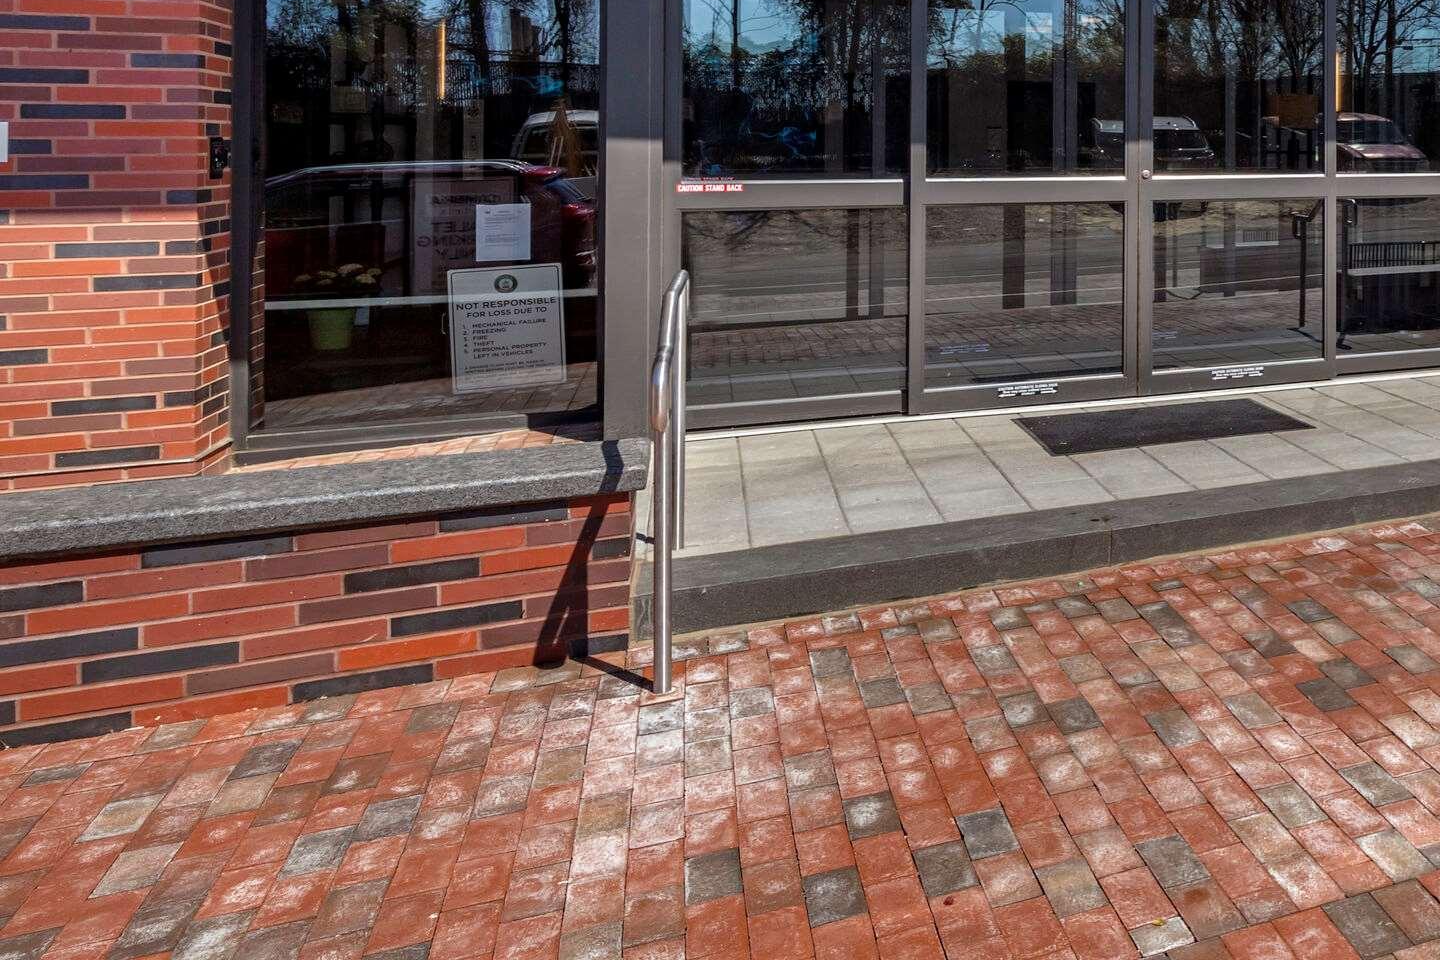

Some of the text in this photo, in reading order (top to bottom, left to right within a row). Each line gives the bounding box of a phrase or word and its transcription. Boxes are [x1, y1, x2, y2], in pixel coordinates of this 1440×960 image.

[677, 184, 743, 192] CAUTION STAND BACK
[456, 296, 557, 311] NOT RESPONSIBLE
[488, 309, 511, 317] LOSS
[513, 307, 533, 315] DUE
[473, 345, 509, 353] PERSONAL
[511, 342, 547, 350] PROPERTY
[501, 349, 534, 357] VEHICLES
